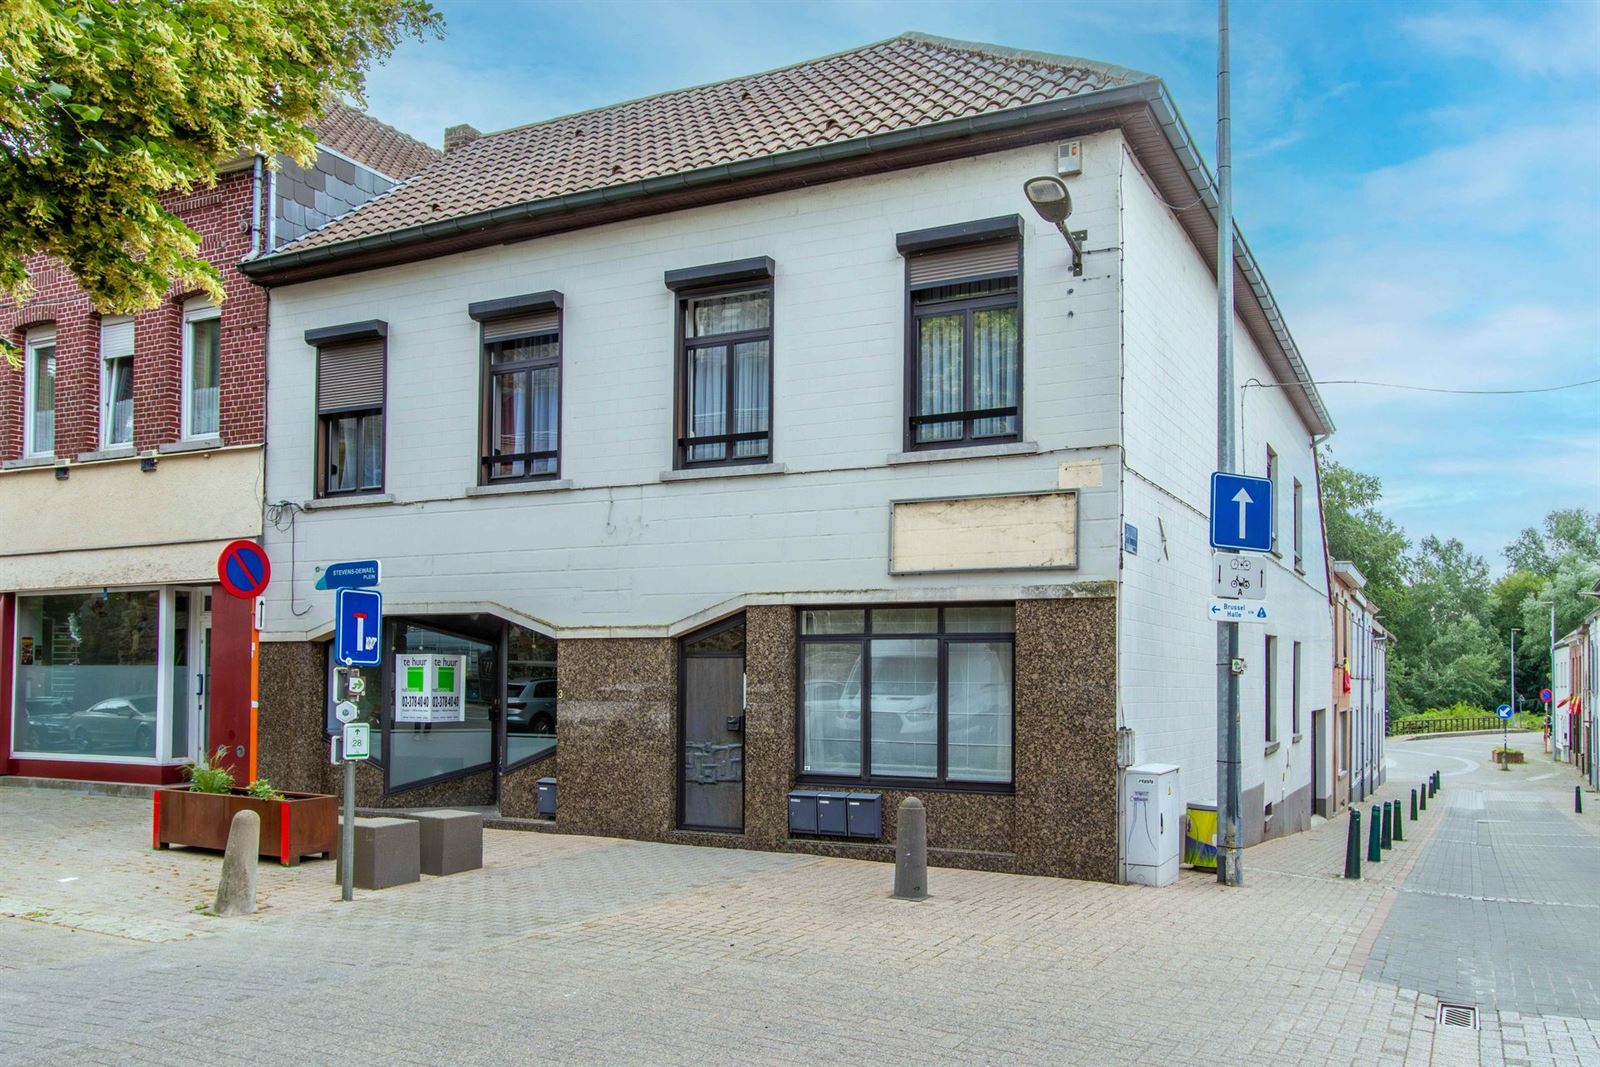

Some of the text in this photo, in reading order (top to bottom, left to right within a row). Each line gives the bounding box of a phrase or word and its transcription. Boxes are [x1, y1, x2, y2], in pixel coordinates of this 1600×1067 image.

[1237, 588, 1243, 596] A
[412, 657, 427, 666] huur
[443, 657, 458, 666] huur
[352, 739, 362, 747] 28
